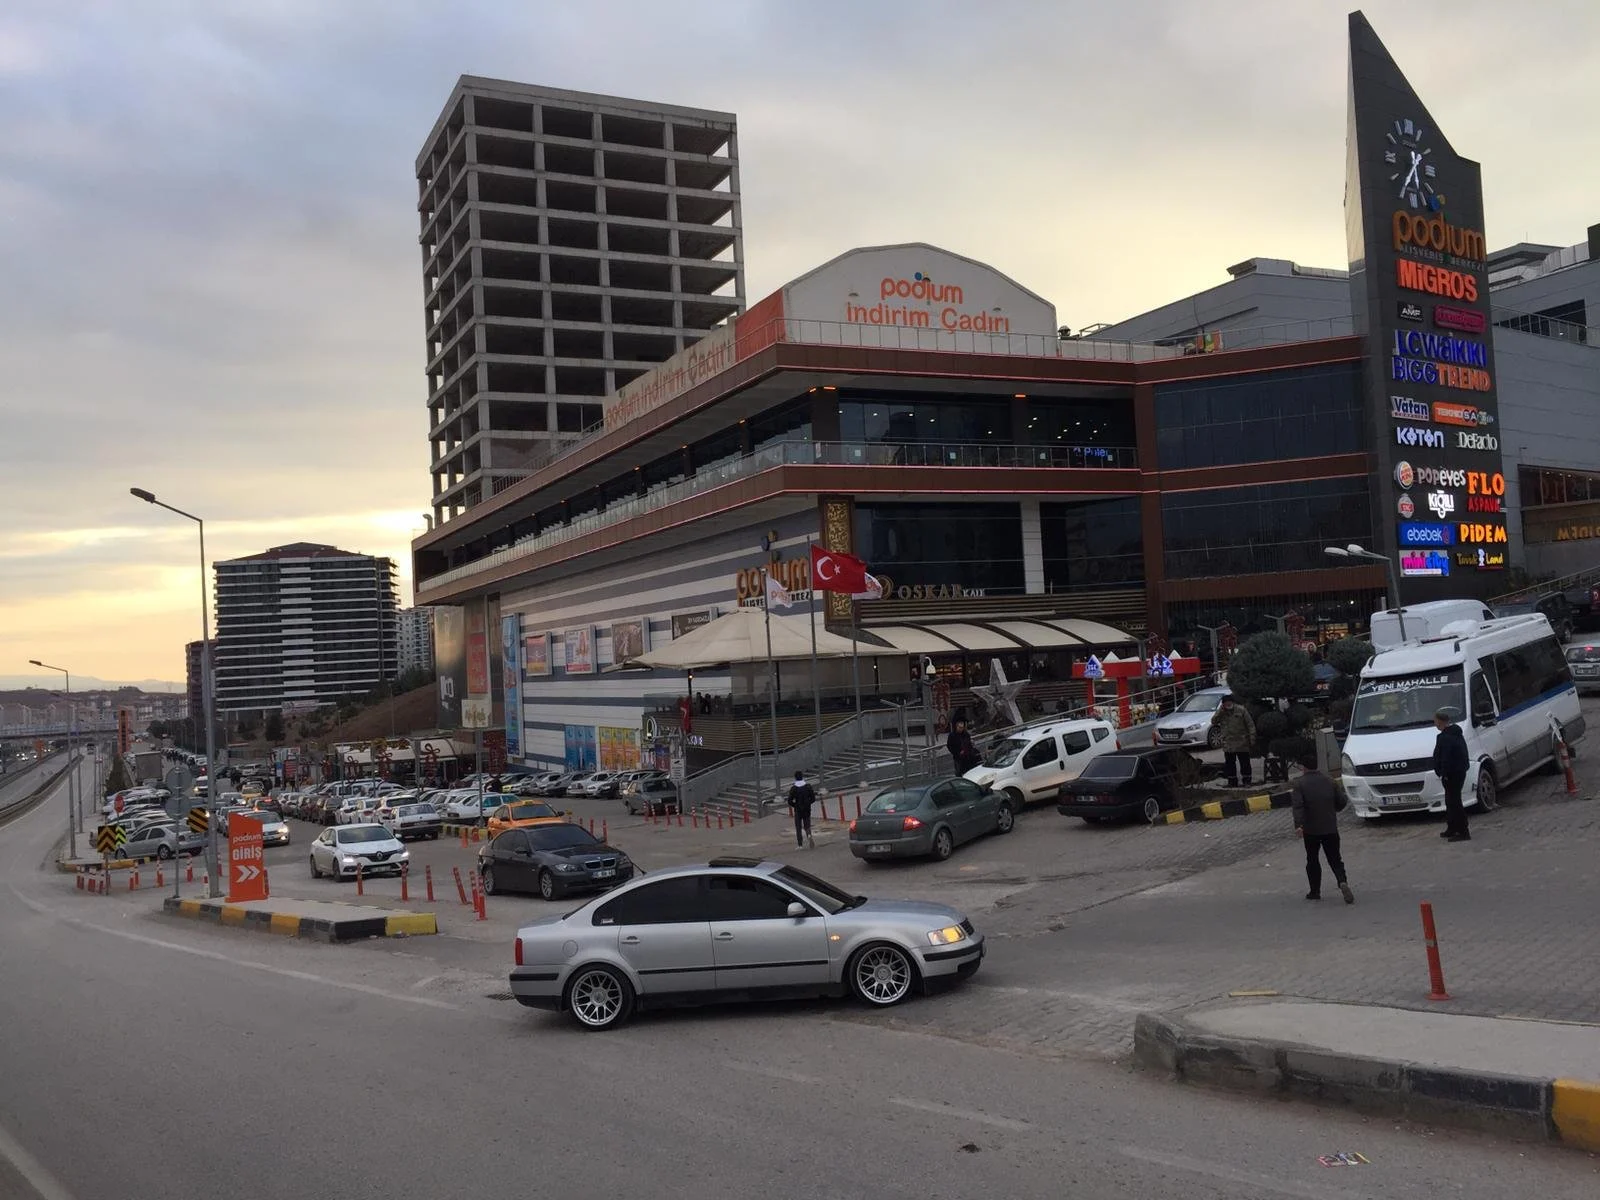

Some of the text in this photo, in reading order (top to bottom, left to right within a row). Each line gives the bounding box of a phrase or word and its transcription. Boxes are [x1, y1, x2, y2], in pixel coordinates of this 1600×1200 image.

[881, 278, 963, 304] podium
[1467, 472, 1505, 496] FLO
[1407, 527, 1442, 542] ebebek
[1397, 675, 1448, 689] MAHALLE
[1380, 762, 1407, 770] IVECO
